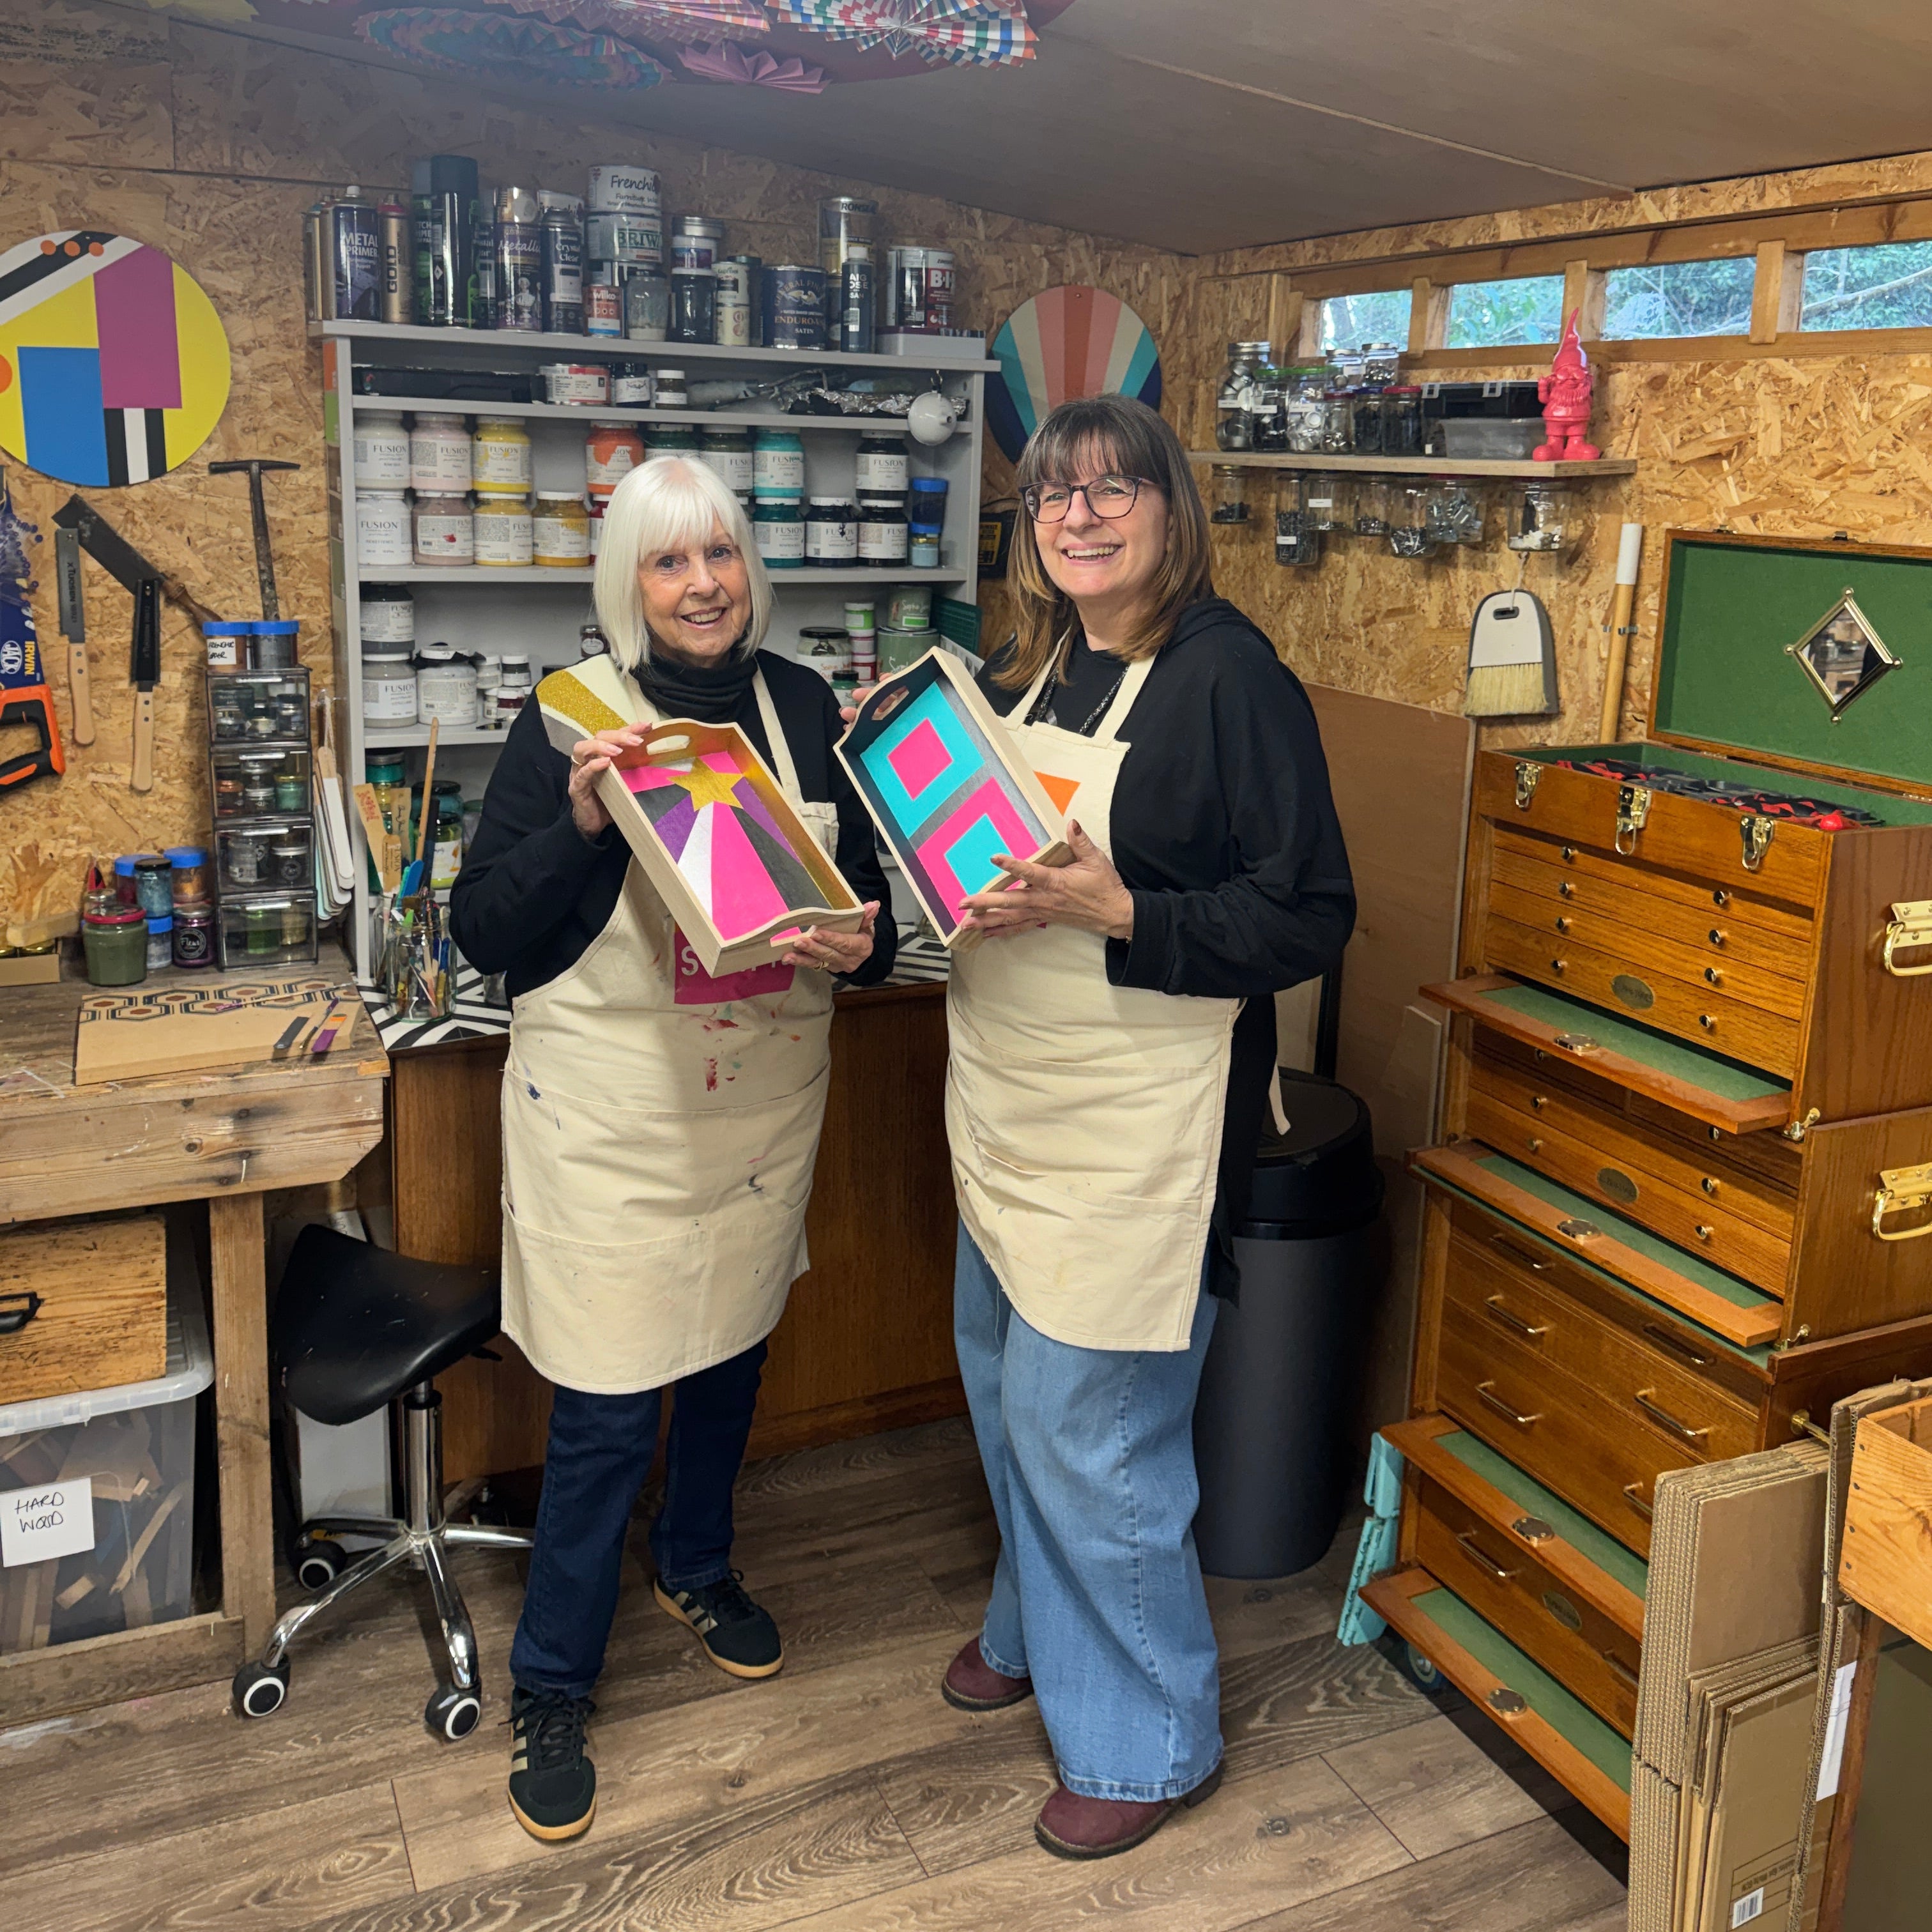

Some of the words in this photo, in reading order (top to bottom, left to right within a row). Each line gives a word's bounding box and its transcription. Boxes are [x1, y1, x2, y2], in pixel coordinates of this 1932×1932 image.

[344, 232, 378, 247] METAL
[346, 245, 378, 257] PRIMER
[387, 246, 397, 293] GOLD
[593, 289, 616, 300] wilko
[373, 445, 407, 453] FUSION
[440, 447, 470, 455] FUSION
[489, 446, 519, 454] FUSION
[873, 459, 904, 467] FUSION
[360, 521, 399, 530] FUSION
[2, 643, 20, 671] JACK
[24, 641, 35, 676] IRWIN
[385, 683, 415, 693] FUSION
[14, 1492, 64, 1514] HARD
[19, 1510, 64, 1533] WOOD
